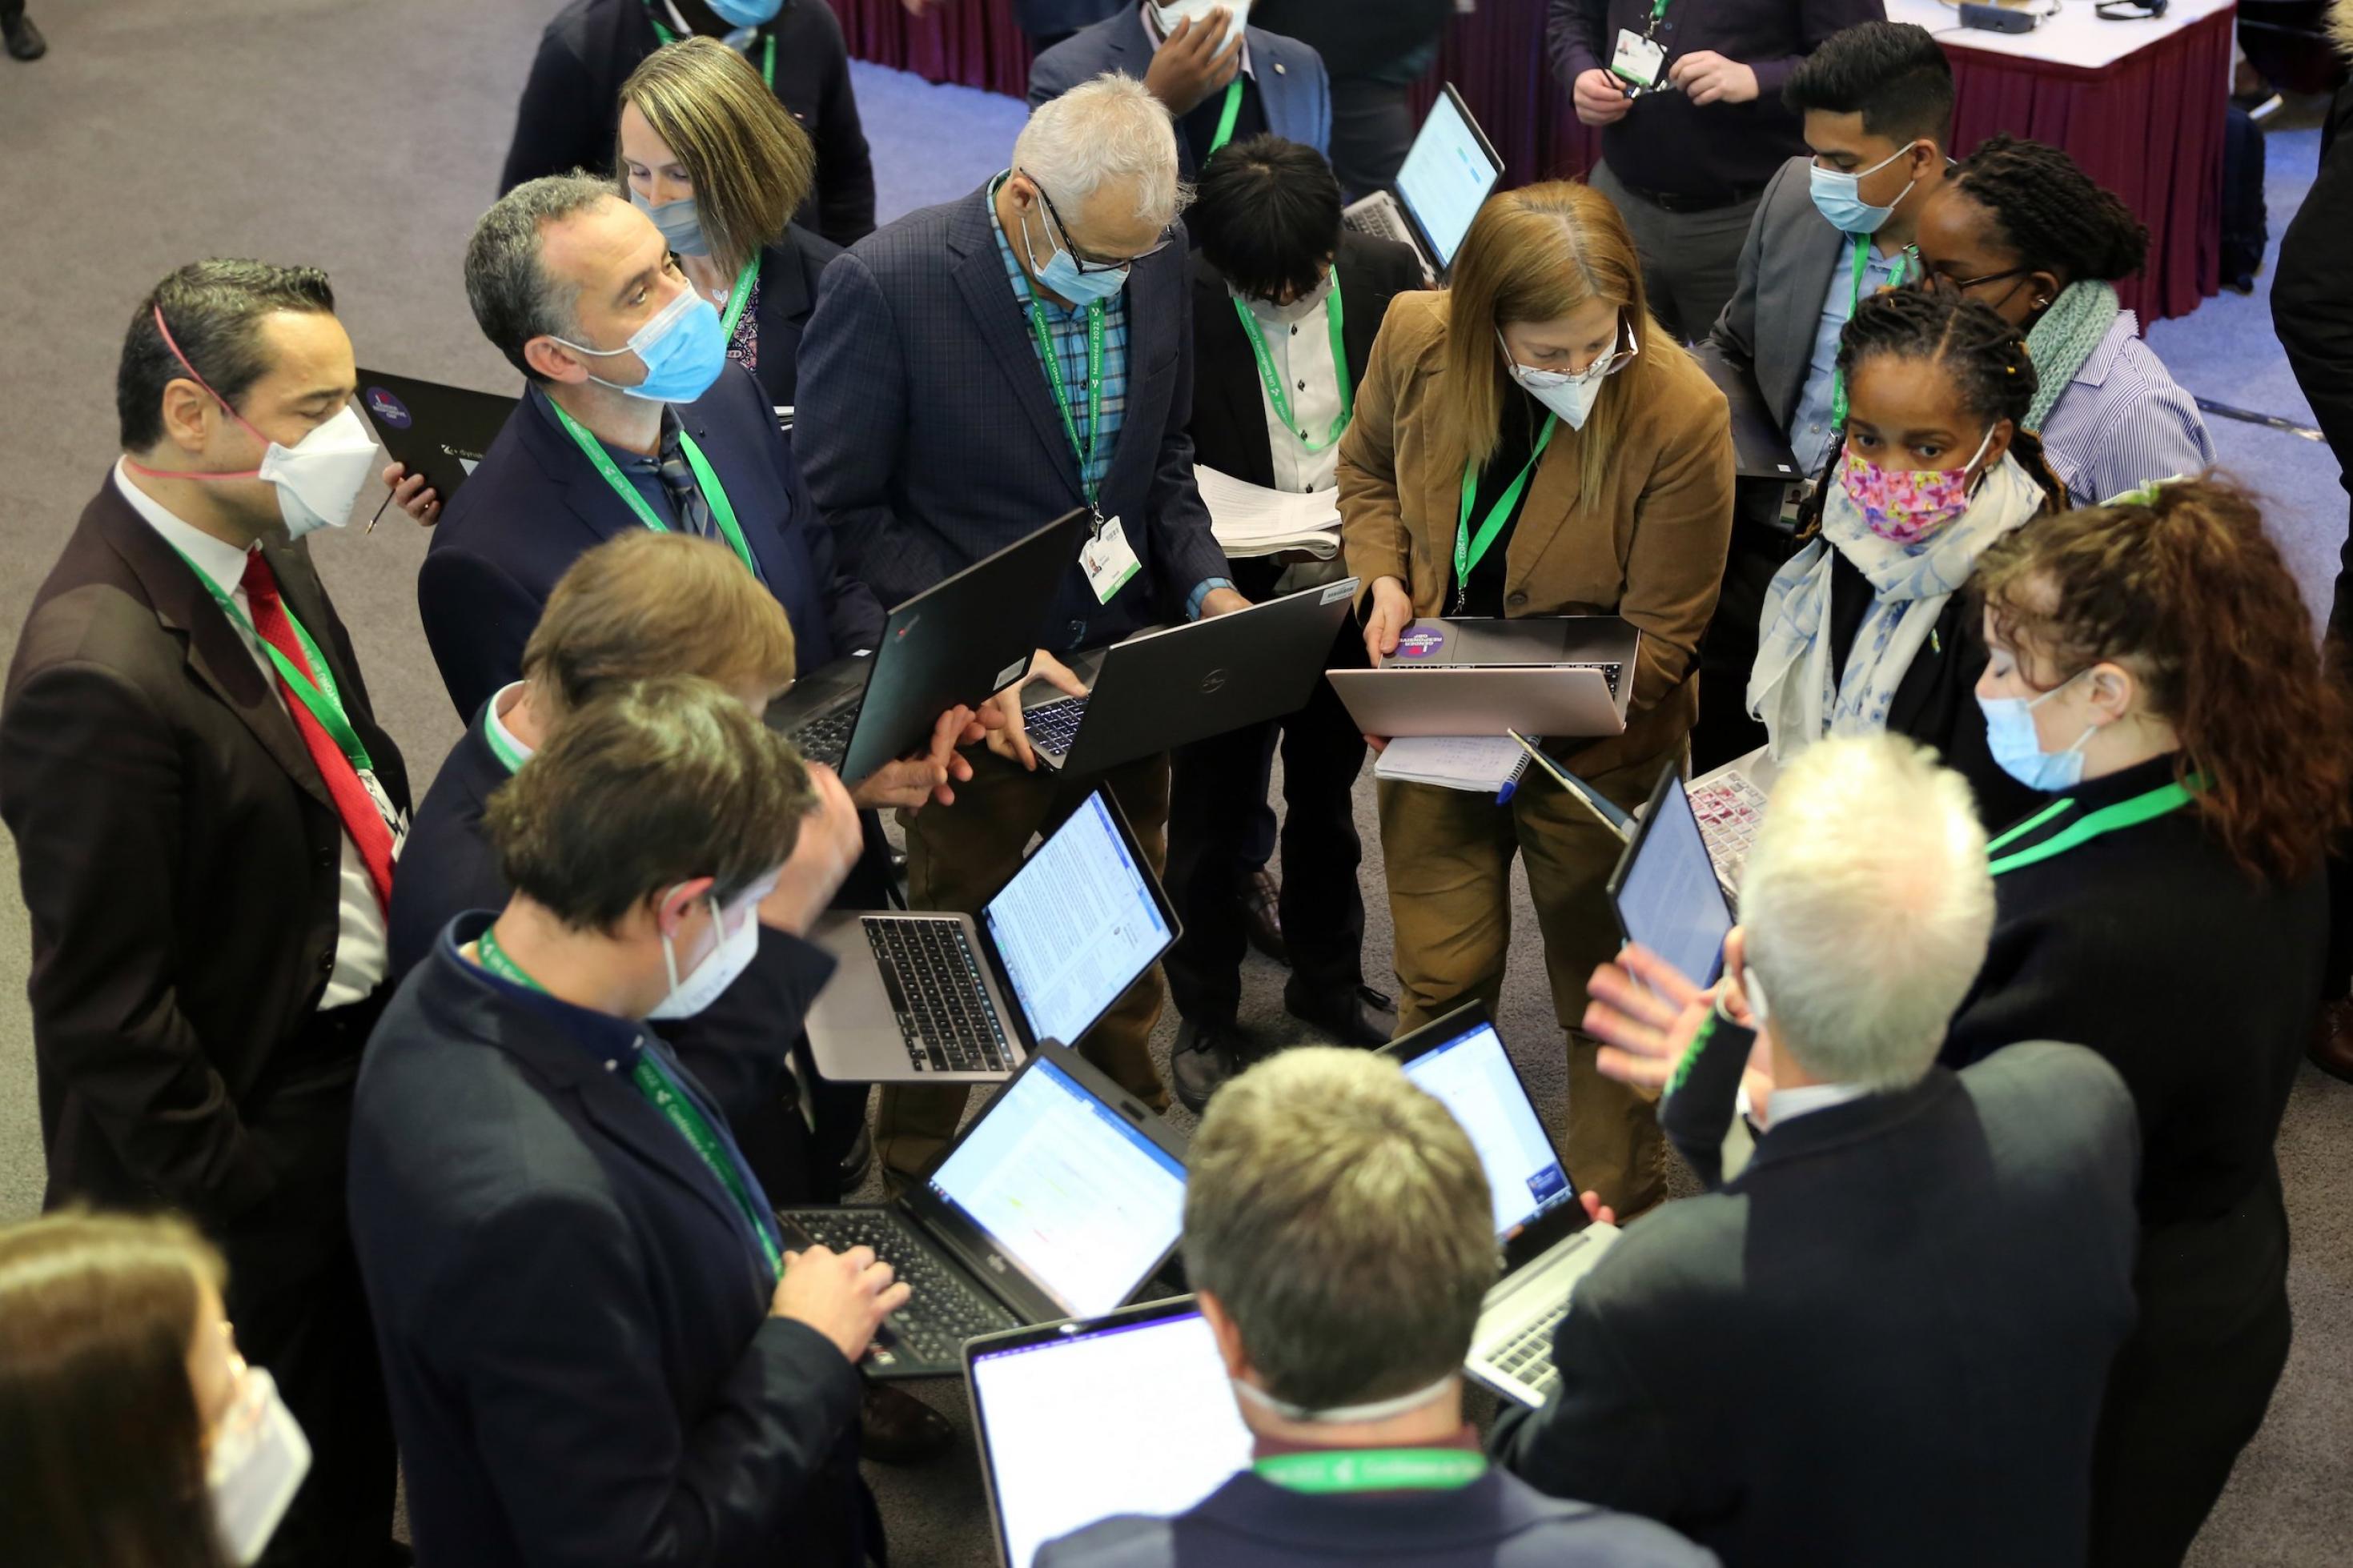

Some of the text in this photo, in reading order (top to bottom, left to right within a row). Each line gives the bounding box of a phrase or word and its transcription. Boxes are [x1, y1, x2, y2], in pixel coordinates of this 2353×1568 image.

[724, 291, 745, 328] Biodiversity
[1035, 311, 1050, 351] Conférence
[1047, 352, 1054, 363] de
[1257, 339, 1273, 376] Biodiversity
[1457, 542, 1467, 559] 2022
